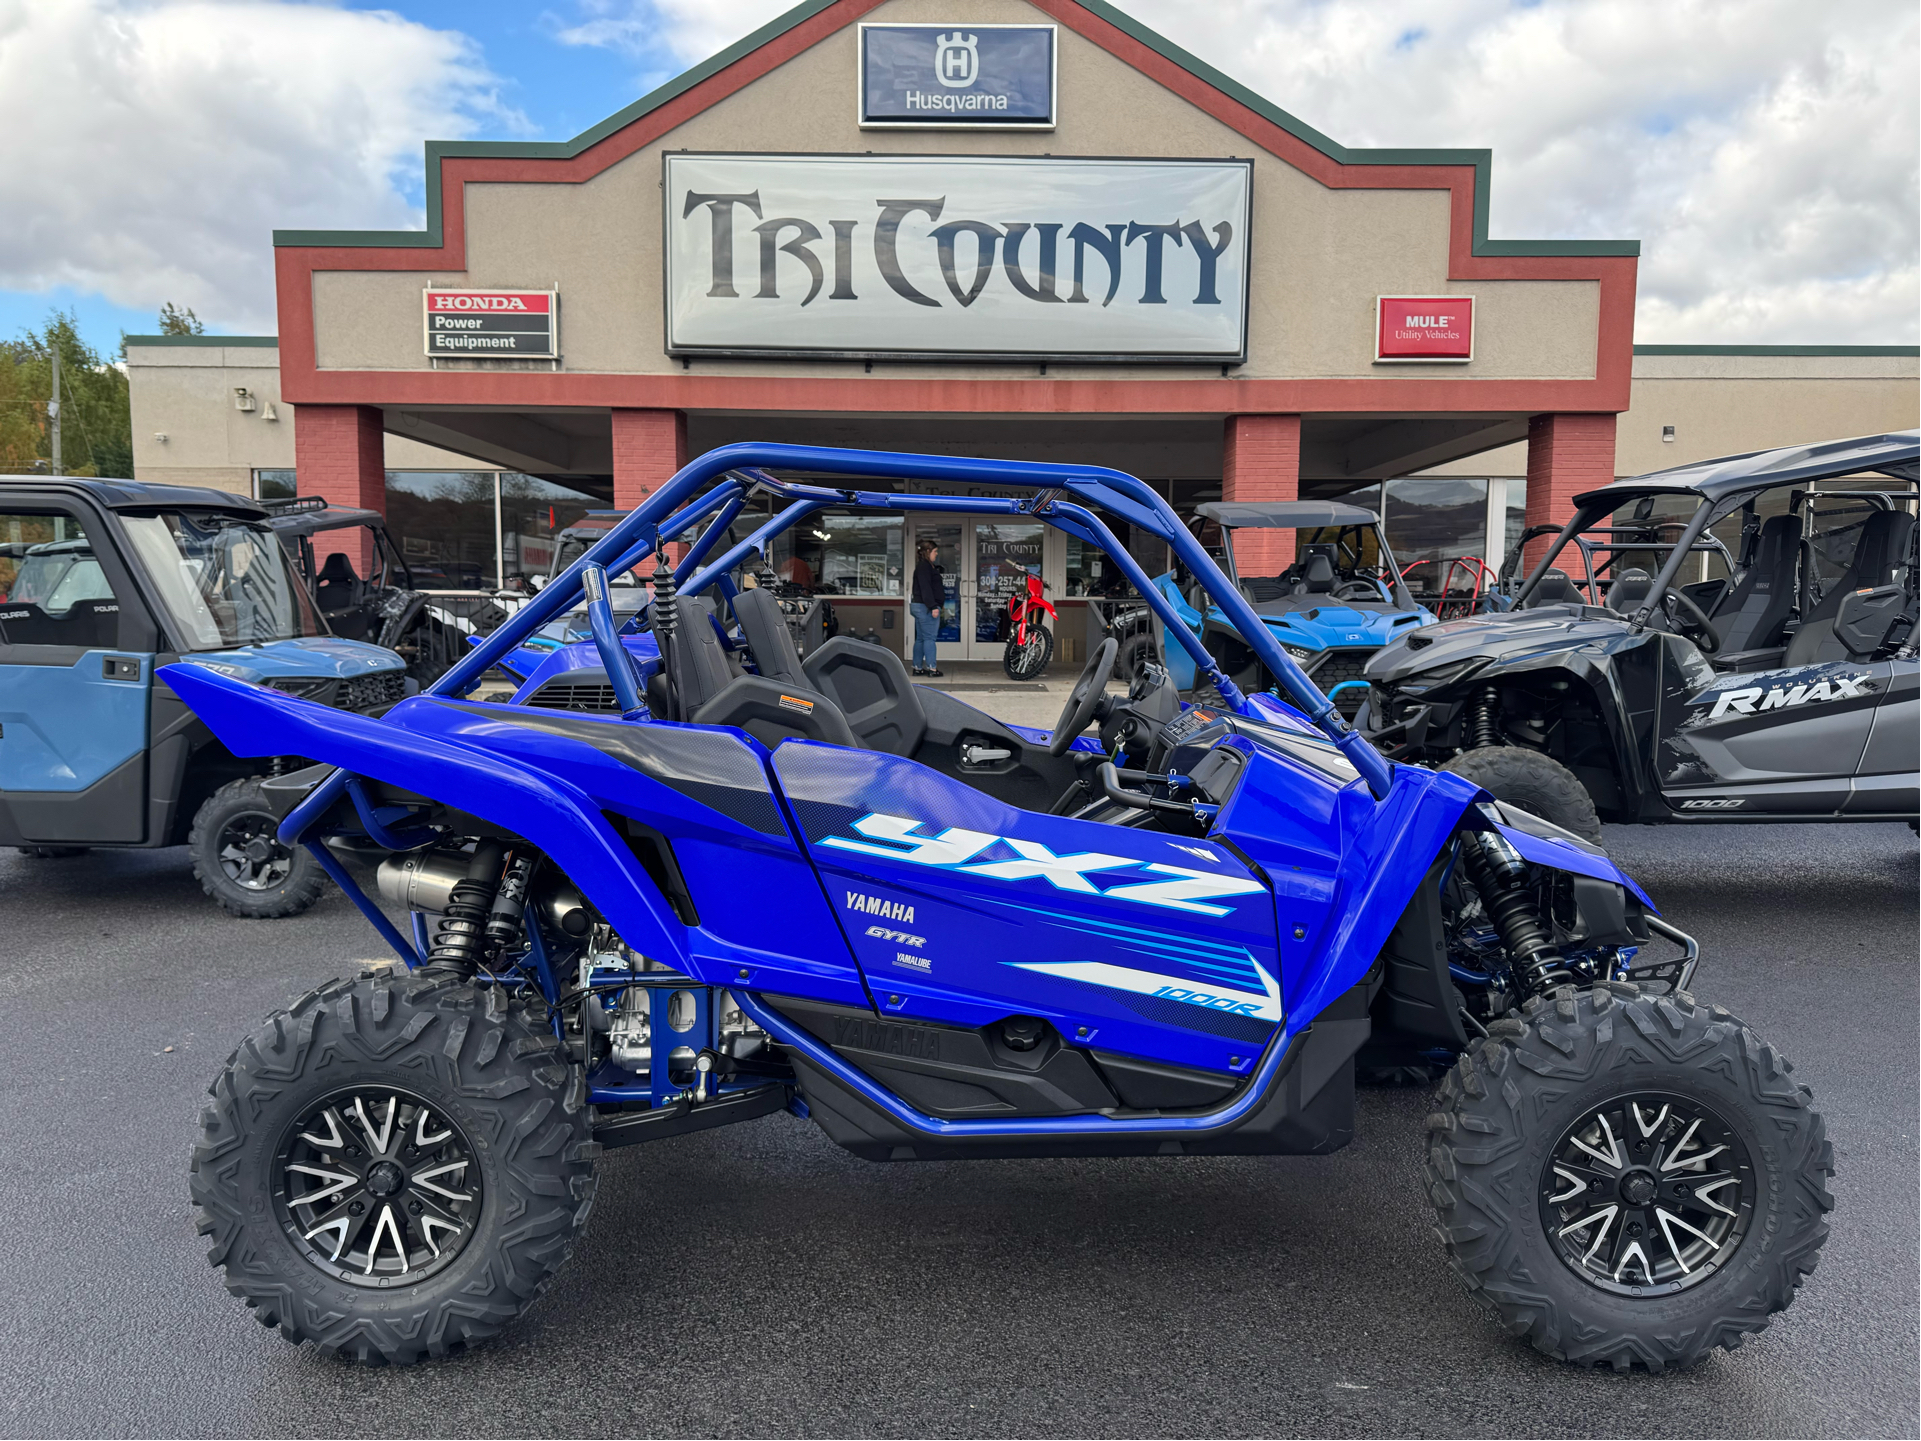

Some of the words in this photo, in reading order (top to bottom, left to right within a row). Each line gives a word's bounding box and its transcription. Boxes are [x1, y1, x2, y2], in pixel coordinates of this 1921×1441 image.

[906, 90, 1008, 113] Husqvarna
[435, 296, 527, 310] HONDA
[435, 316, 483, 329] Power
[435, 334, 516, 350] Equipment
[1395, 330, 1423, 341] Utility
[1425, 330, 1460, 340] Vehicles
[980, 576, 1026, 586] 304-257-44
[0, 610, 30, 620] OLARIS
[1772, 670, 1873, 689] WOLVERINE
[1680, 799, 1746, 809] 1000
[814, 812, 1267, 917] YXZ
[846, 890, 915, 924] YAMAHA
[865, 925, 927, 949] GYTR
[896, 952, 932, 969] YAMALUBE
[1152, 986, 1264, 1018] 1000R
[833, 1016, 940, 1060] YAMAHA
